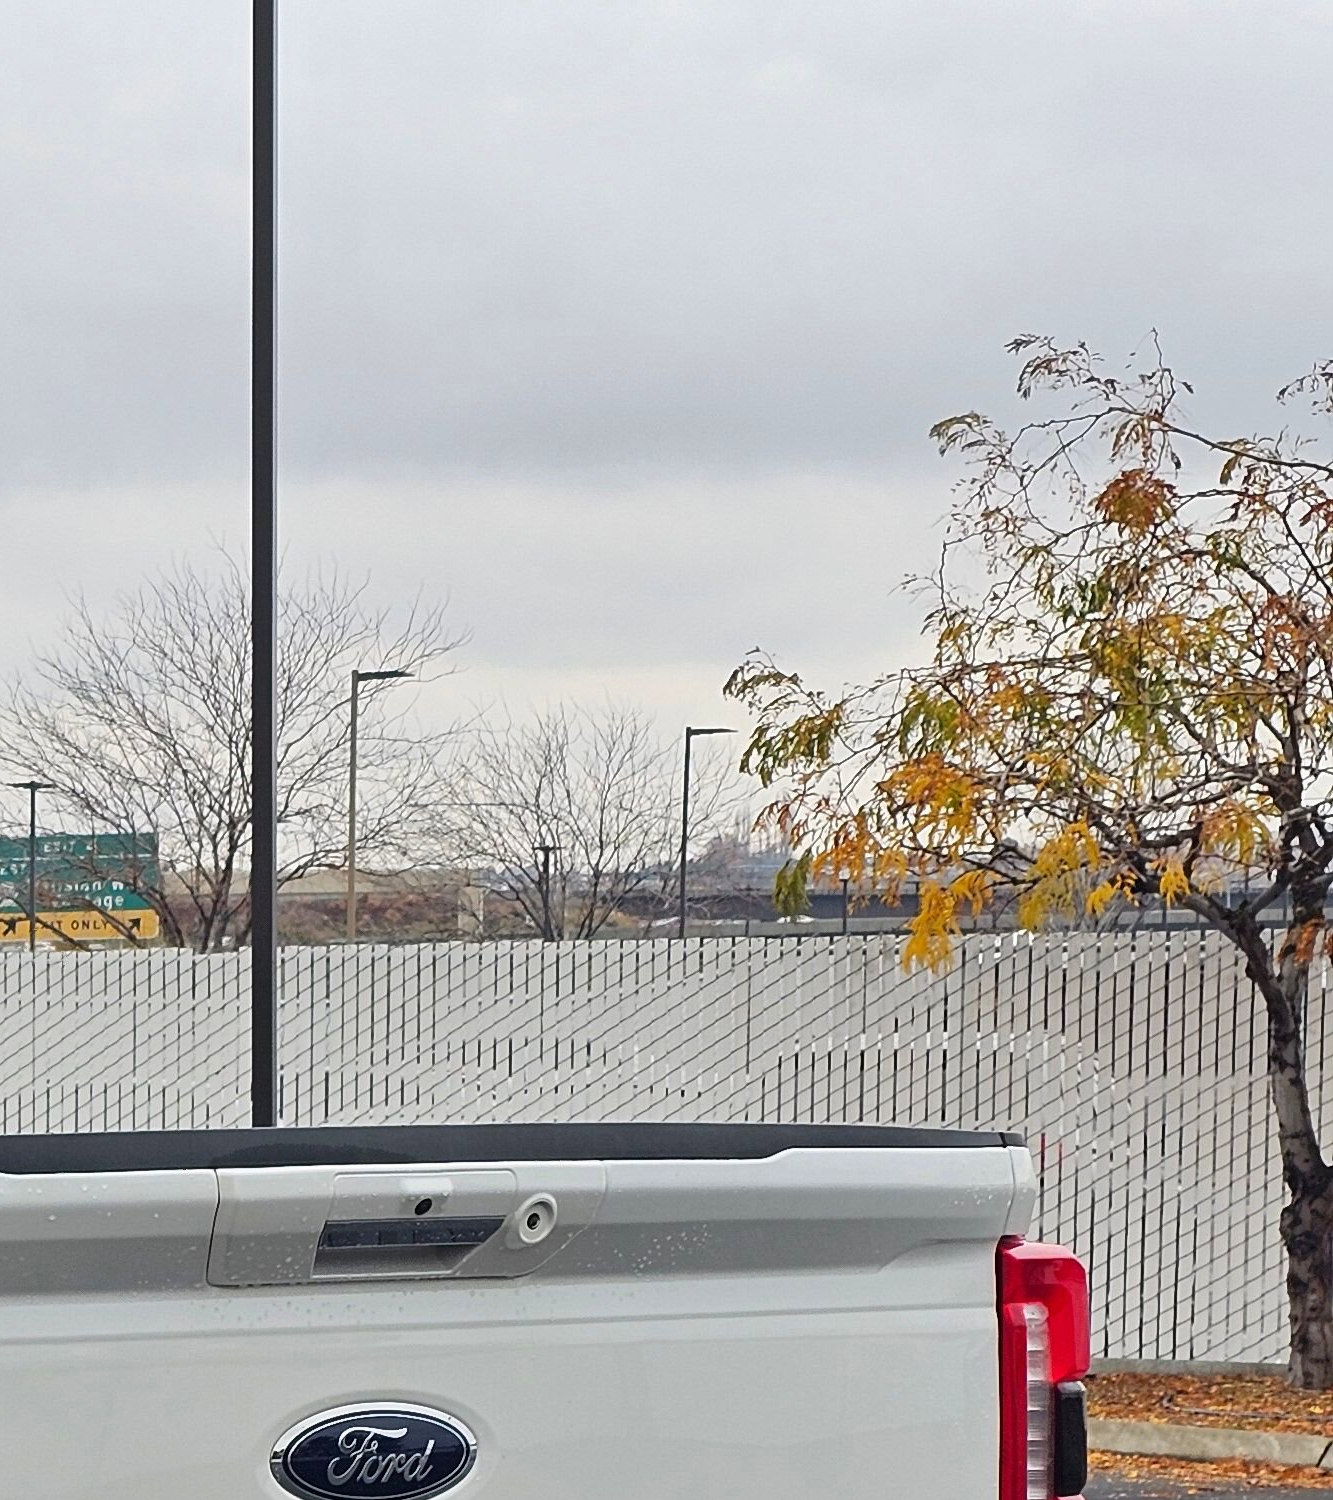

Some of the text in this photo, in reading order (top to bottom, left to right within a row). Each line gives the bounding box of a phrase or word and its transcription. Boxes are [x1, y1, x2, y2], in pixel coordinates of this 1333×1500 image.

[33, 919, 109, 931] XIT ONLY
[326, 1425, 437, 1487] Ford
